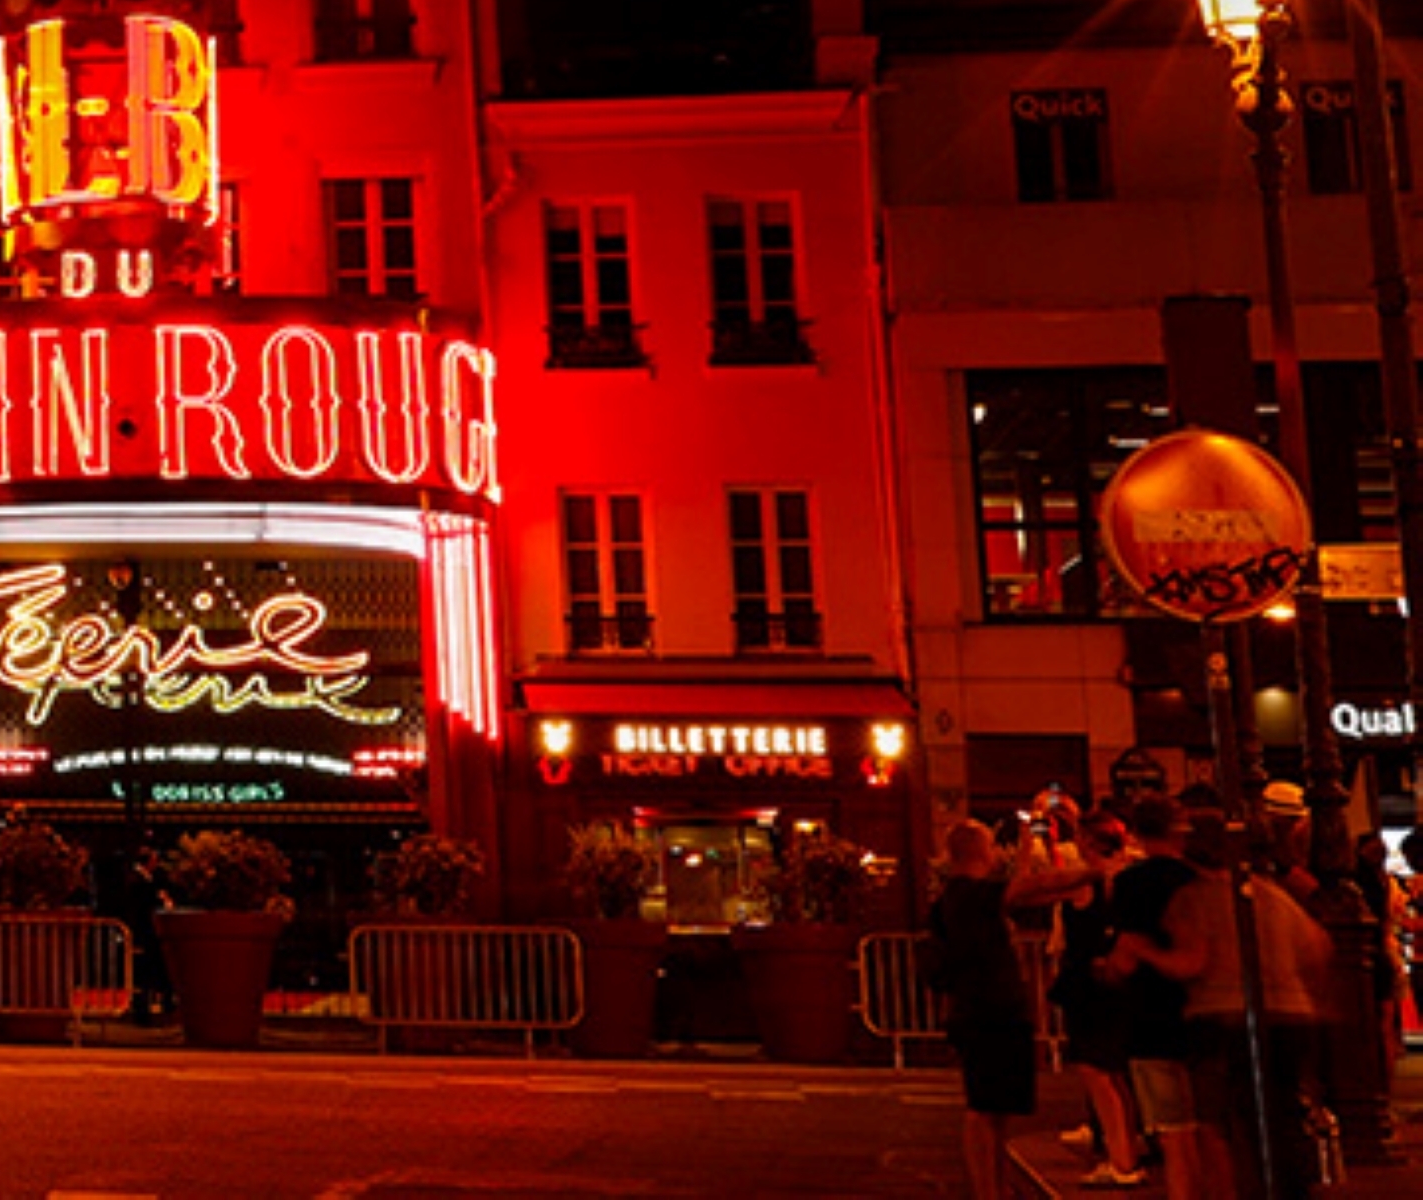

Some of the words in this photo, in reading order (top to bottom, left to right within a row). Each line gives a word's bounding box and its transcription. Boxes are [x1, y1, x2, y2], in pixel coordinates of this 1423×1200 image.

[1013, 92, 1104, 121] Quick
[60, 250, 154, 298] DU
[155, 325, 503, 505] ROUG
[615, 724, 827, 754] BILLETTERIE
[1331, 702, 1416, 740] Qual
